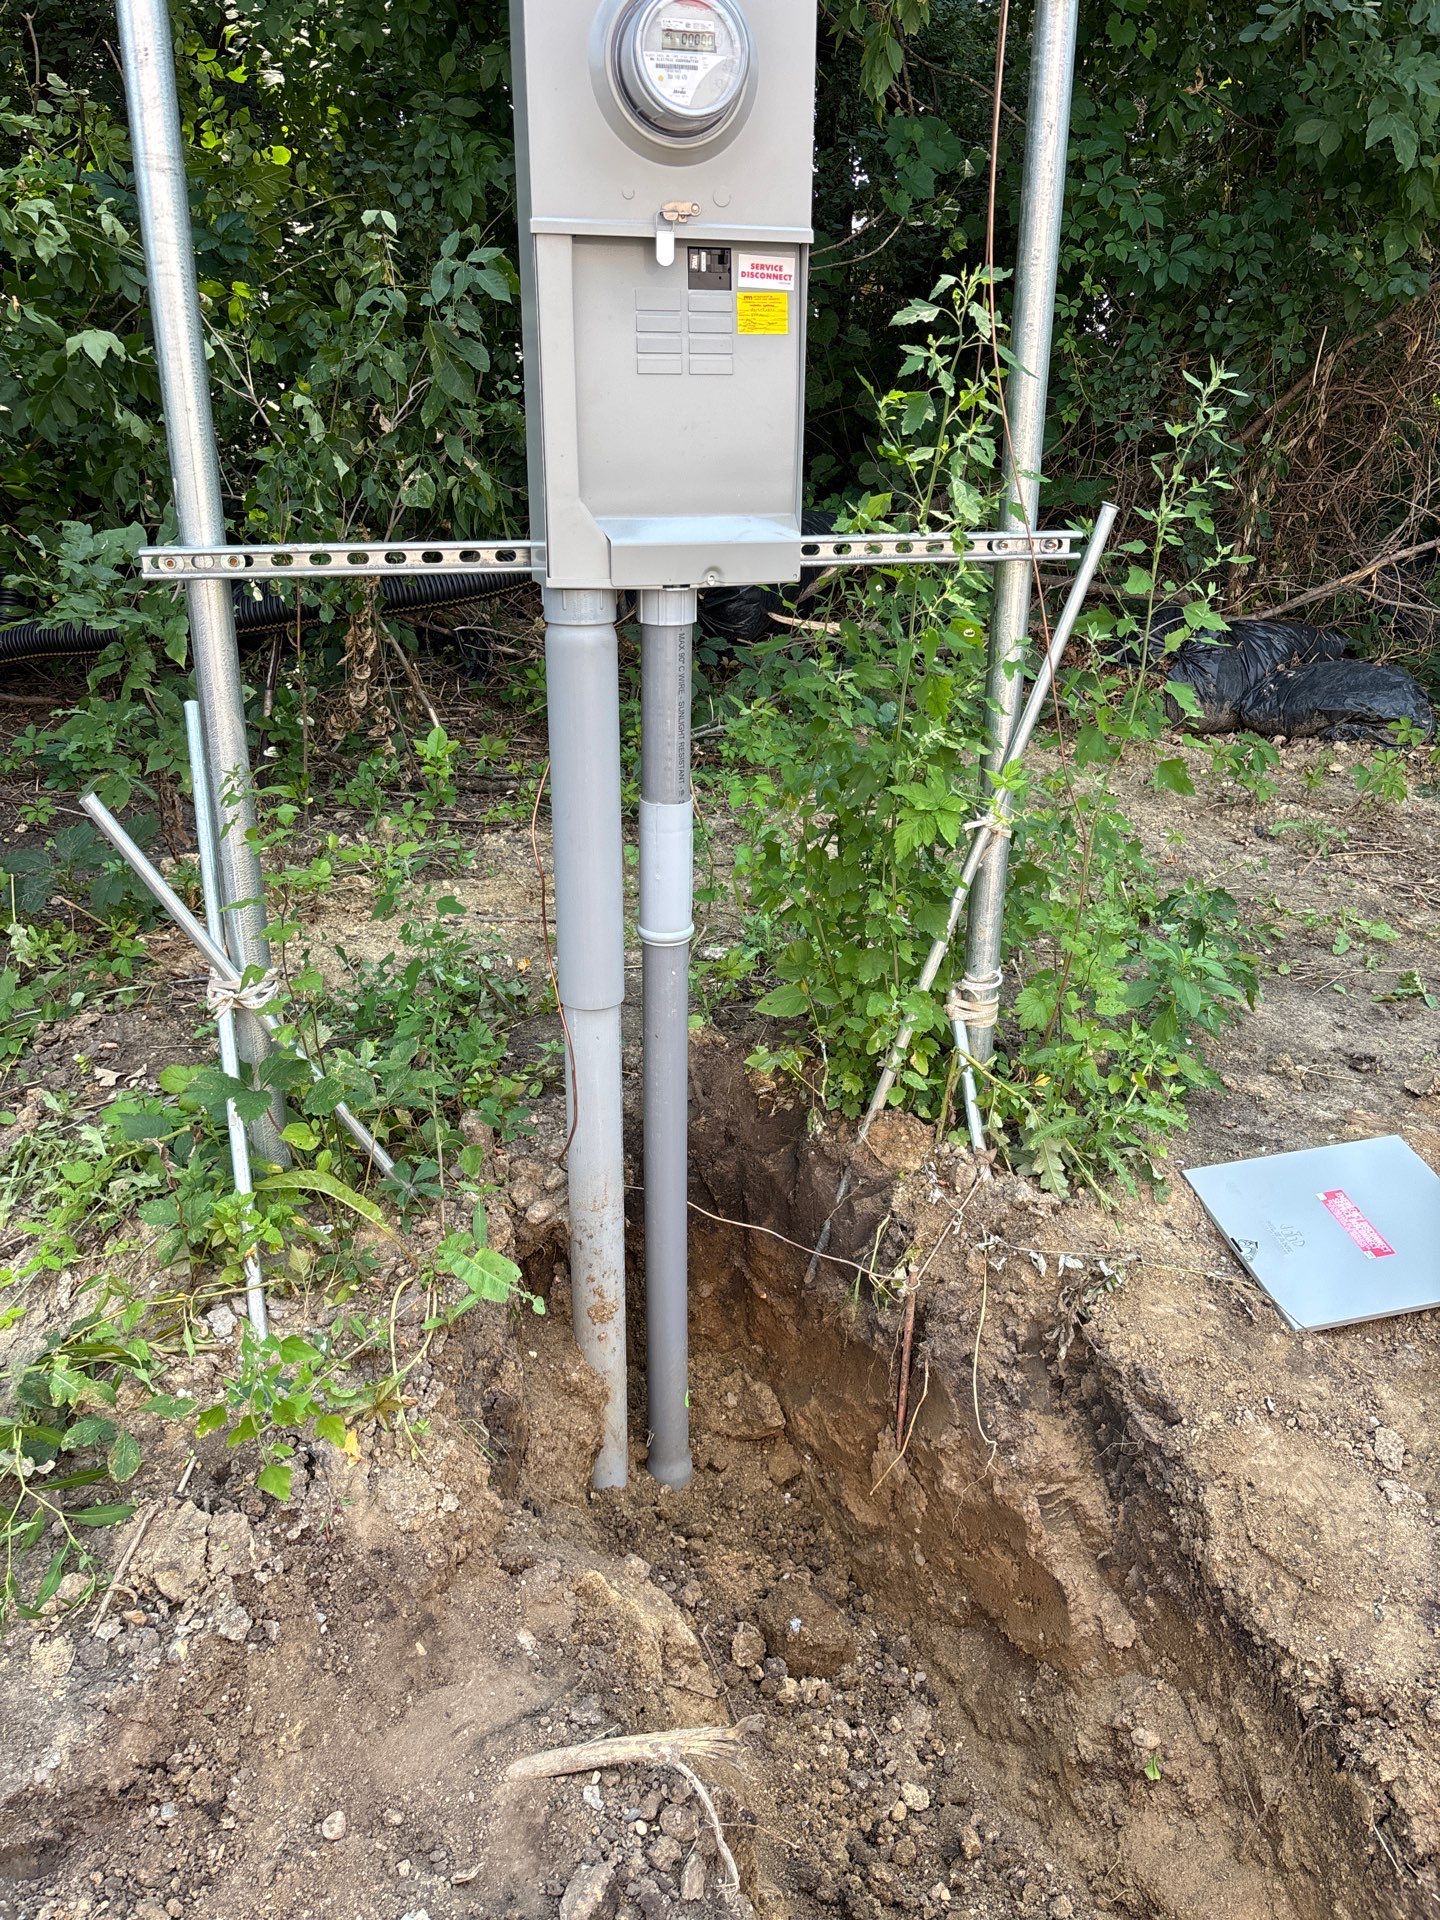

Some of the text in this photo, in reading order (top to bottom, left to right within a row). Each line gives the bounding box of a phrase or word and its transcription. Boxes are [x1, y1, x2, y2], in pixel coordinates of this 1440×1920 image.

[750, 263, 784, 272] SERVICE
[741, 271, 793, 282] DISCONNECT
[678, 632, 686, 651] MAX
[678, 675, 686, 695] WIRE
